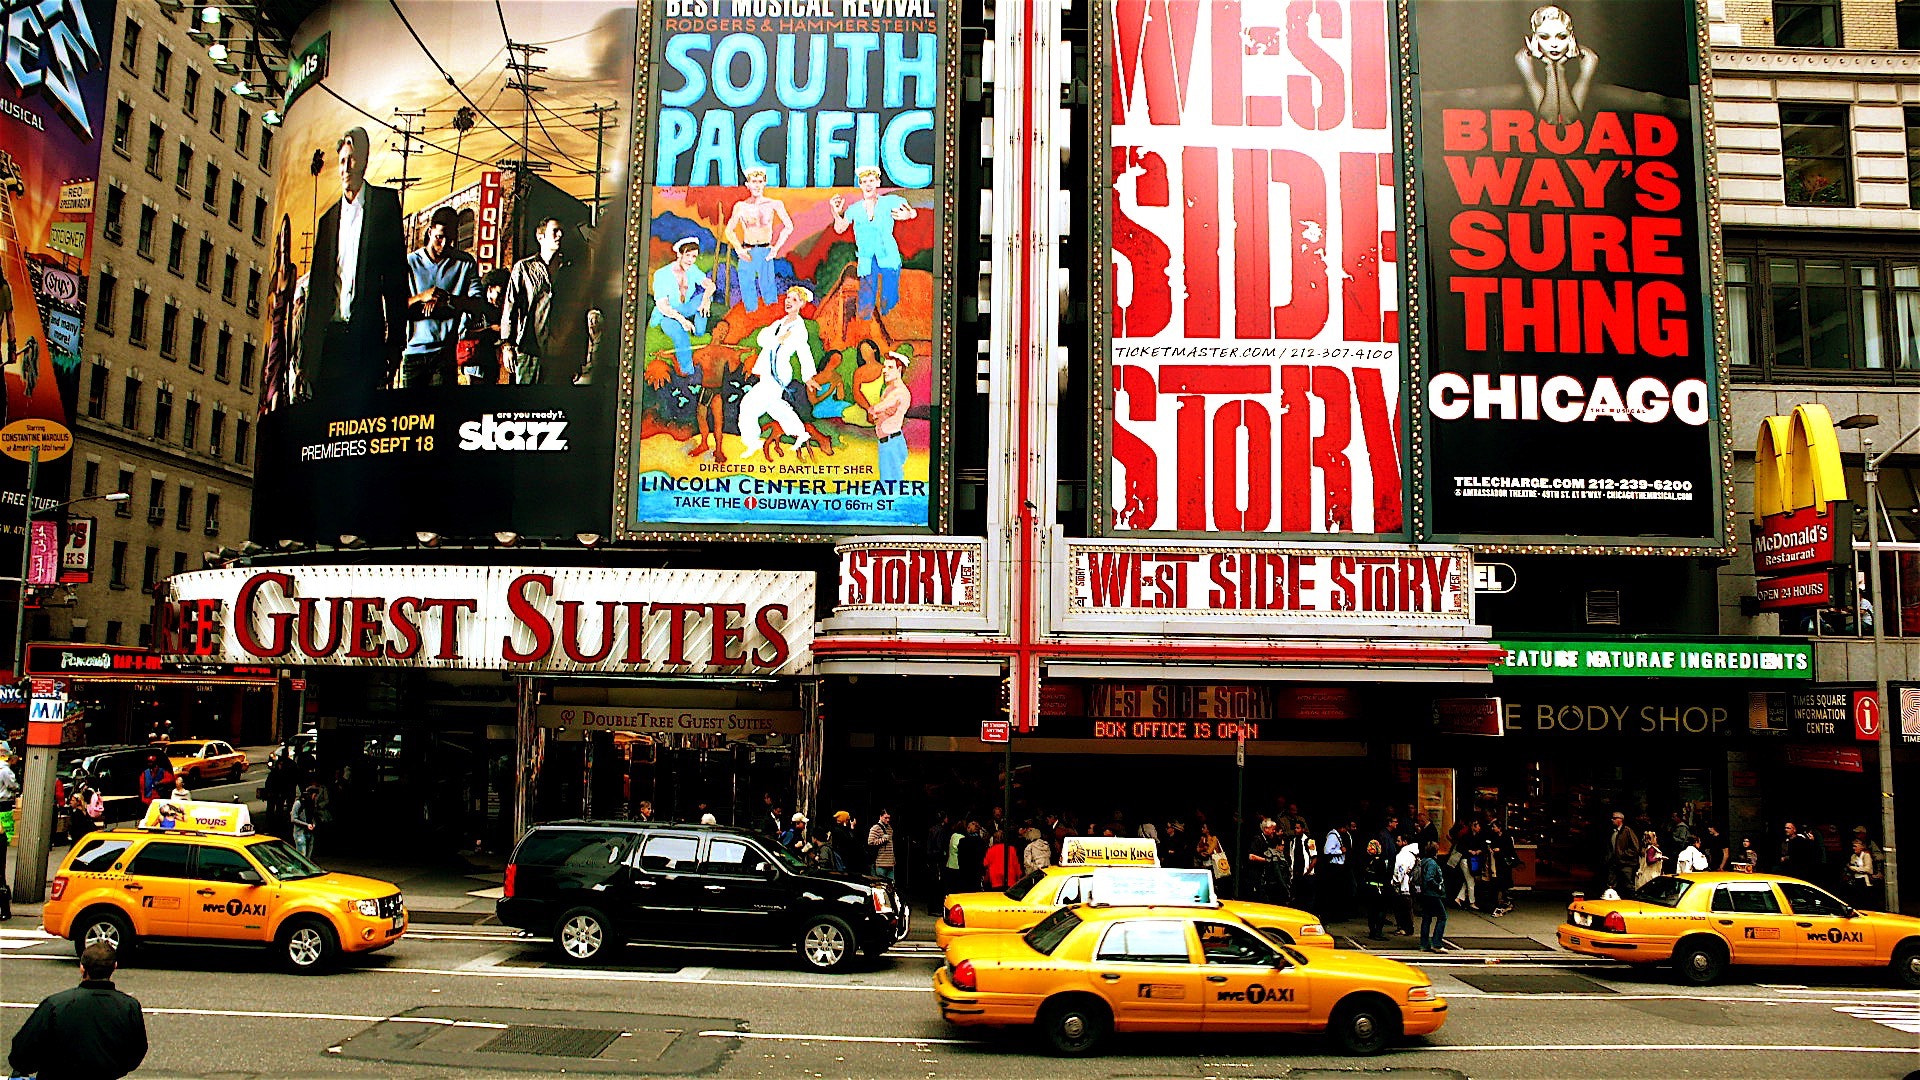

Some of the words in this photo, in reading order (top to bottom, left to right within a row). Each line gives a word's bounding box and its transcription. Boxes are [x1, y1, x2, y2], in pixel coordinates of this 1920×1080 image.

[666, 0, 721, 17] BEST
[731, 0, 833, 17] MUSICAL
[843, 0, 935, 17] REVIVAL
[666, 18, 755, 32] RODGERS
[760, 18, 773, 32] &
[779, 18, 938, 33] HAMMERSTEIN'S
[661, 32, 938, 110] SOUTH
[1442, 108, 1679, 157] BROAD
[655, 107, 935, 189] PACIFIC
[68, 186, 83, 198] REO
[1443, 156, 1681, 212] WAY'S
[1111, 145, 1399, 343] SIDE
[1449, 210, 1685, 275] SURE
[1449, 276, 1689, 358] THING
[61, 319, 79, 337] many
[1115, 346, 1277, 360] TICKETMASTER.COM
[1428, 372, 1710, 426] CHICAGO
[328, 416, 387, 438] FRIDAYS
[391, 413, 435, 432] 10PM
[513, 412, 530, 421] you
[459, 413, 569, 451] starz
[301, 439, 367, 462] PREMIERES
[369, 436, 411, 454] SEPT
[415, 435, 434, 452] 18
[1111, 364, 1403, 533] STORY
[699, 463, 755, 473] DIRECTED
[759, 465, 776, 474] BY
[779, 465, 841, 475] BARTLETT
[843, 465, 874, 475] SHER
[641, 476, 731, 493] LINCOLN
[738, 478, 827, 495] CENTER
[832, 479, 926, 497] THEATER
[1453, 476, 1586, 490] TELECHARGE.COM
[1587, 478, 1693, 491] 212-239-6200
[1, 491, 27, 507] FREE
[31, 495, 60, 512] TUFF!
[673, 496, 710, 508] TAKE
[713, 497, 741, 508] THE
[758, 498, 820, 511] SUBWAY
[823, 499, 842, 511] TO
[845, 499, 873, 511] 66TH
[876, 499, 898, 512] ST.
[1754, 524, 1828, 554] McDonald's
[1765, 547, 1816, 566] Restaurant
[848, 549, 963, 606] STORY
[1087, 551, 1200, 609] WEST
[1208, 553, 1317, 611] SIDE
[1330, 555, 1453, 614] STORY
[1757, 588, 1779, 601] OPEN
[1781, 587, 1792, 599] 24
[1793, 583, 1824, 597] HOURS
[155, 598, 223, 656] REE
[234, 571, 477, 659] GUEST
[502, 572, 791, 668] SUITES
[1680, 651, 1808, 670] INGREDIENTS
[0, 688, 22, 699] NYC
[1087, 684, 1148, 717] WEST
[1151, 685, 1208, 719] SIDE
[1213, 685, 1273, 719] STORY
[1792, 694, 1815, 706] TIMES
[1816, 694, 1847, 708] SQUARE
[677, 713, 725, 729] GUEST
[728, 714, 773, 730] SUITES
[1537, 704, 1629, 732] BODY
[1641, 706, 1728, 734] SHOP
[1794, 708, 1846, 721] INFORMATION
[1095, 721, 1127, 738] BOX
[1133, 721, 1187, 738] OFFICE
[1193, 722, 1211, 738] IS
[1806, 722, 1835, 734] CENTER
[195, 817, 227, 827] YOURS
[1086, 848, 1103, 857] THE
[1105, 846, 1128, 860] LION
[1130, 846, 1154, 860] KING
[202, 903, 225, 913] NYC
[226, 898, 267, 917] TAXI
[1807, 932, 1827, 942] NYC
[1827, 927, 1863, 944] TAXI
[1246, 983, 1295, 1005] TAXI
